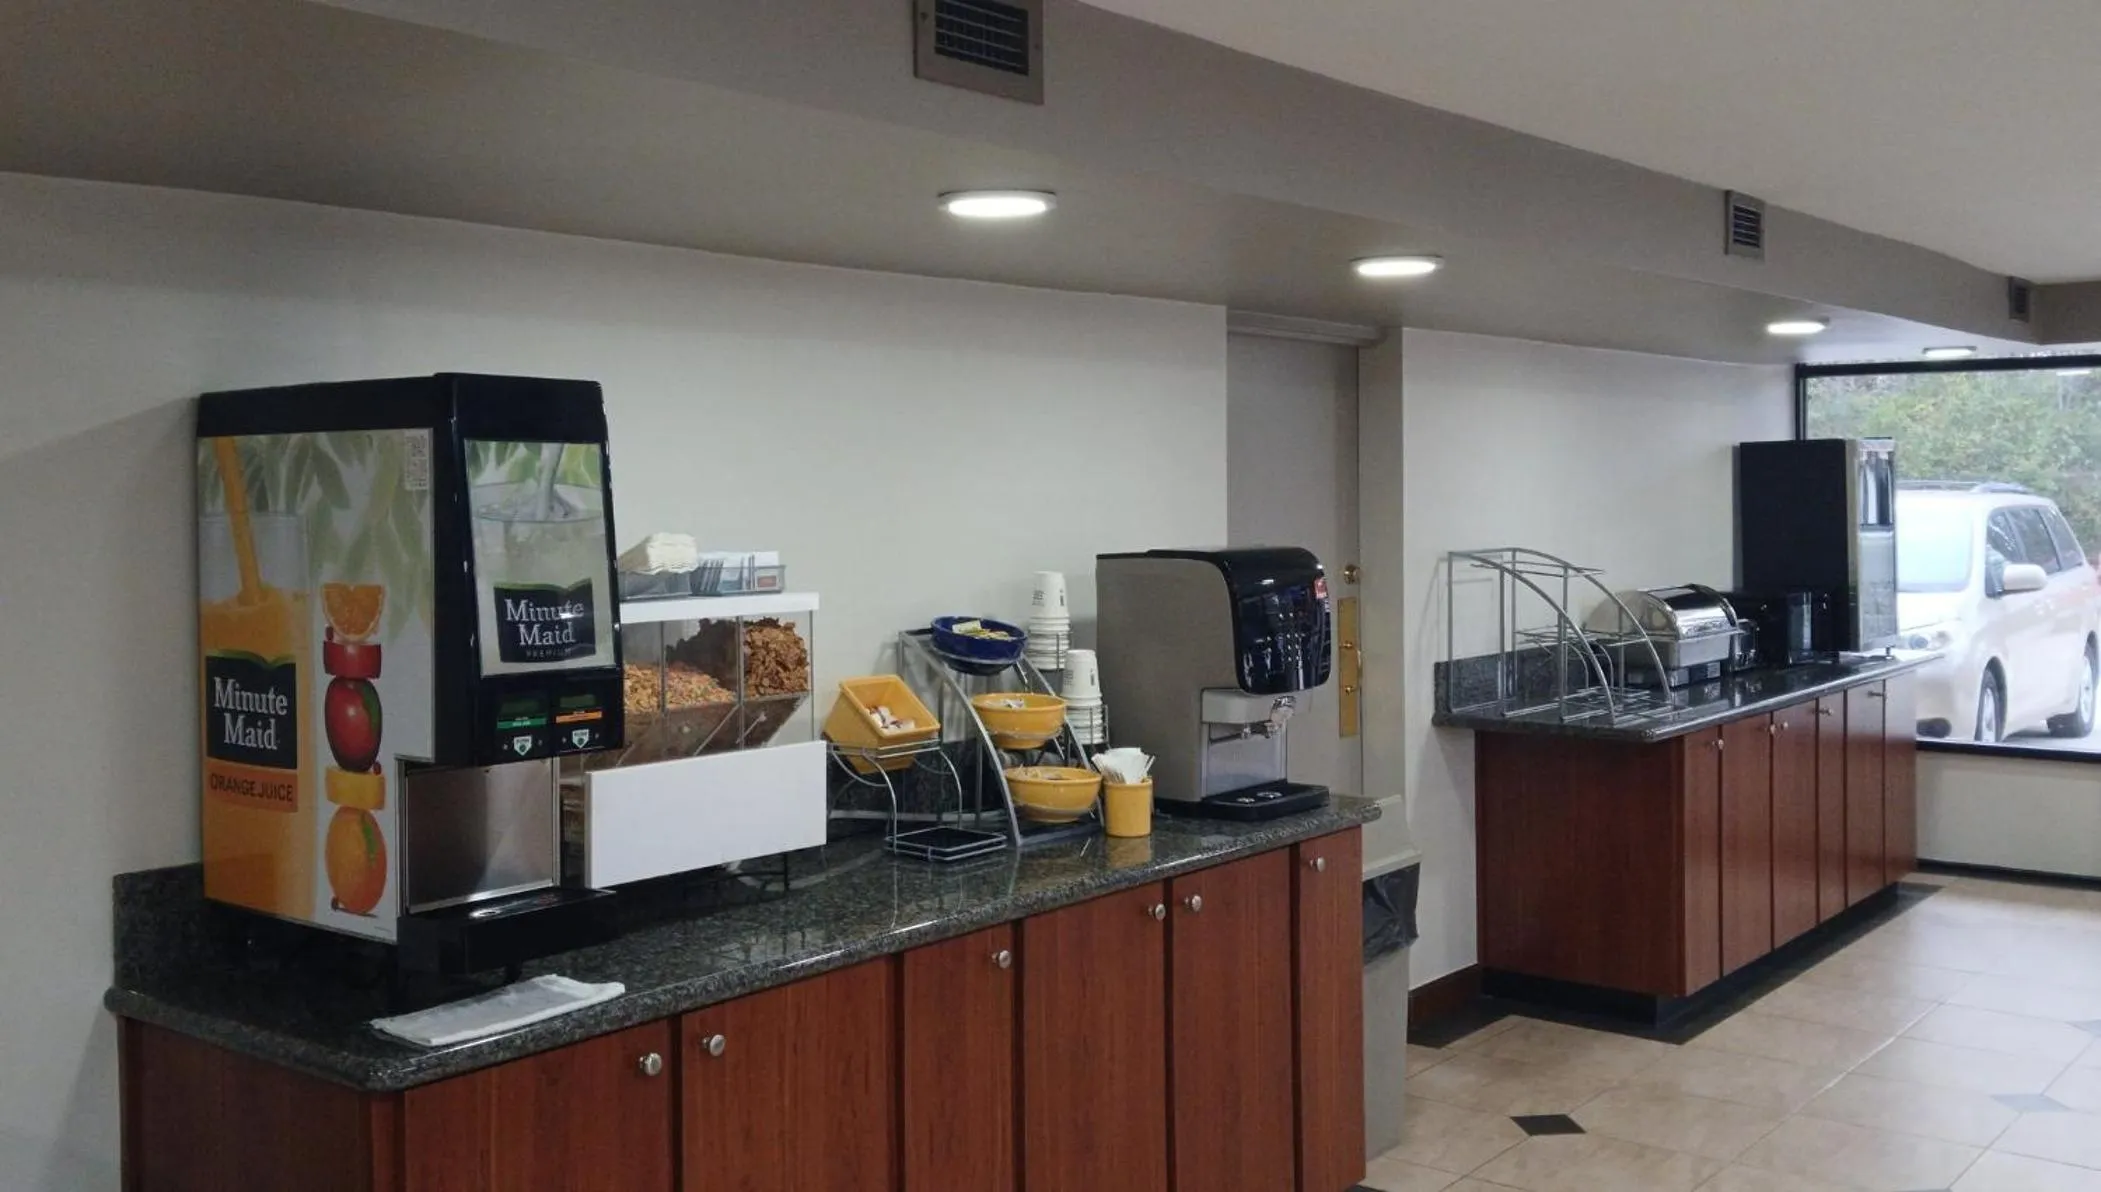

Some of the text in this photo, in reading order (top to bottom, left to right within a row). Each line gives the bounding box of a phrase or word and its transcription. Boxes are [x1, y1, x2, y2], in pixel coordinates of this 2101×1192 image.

[504, 598, 584, 621] Minute
[518, 621, 576, 646] Maid
[213, 677, 288, 715] Minute
[223, 712, 278, 750] Maid
[211, 773, 293, 802] ORANGE JUICE
